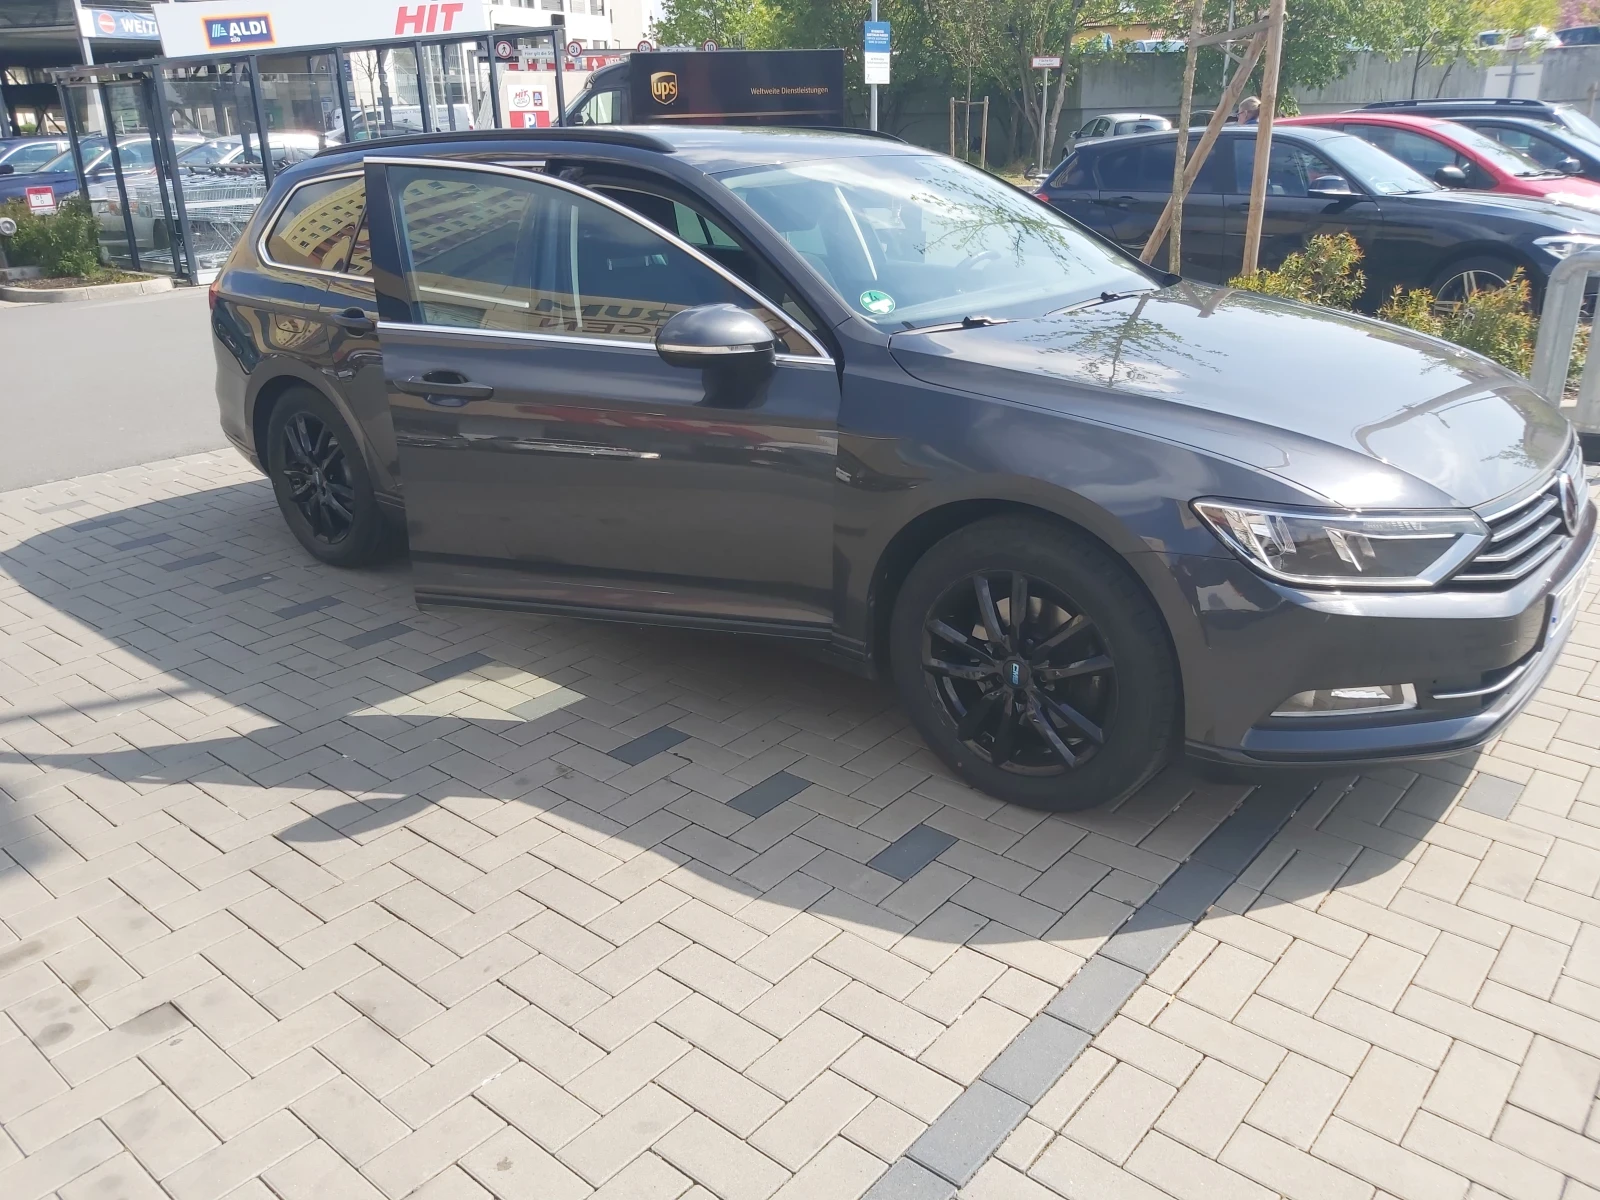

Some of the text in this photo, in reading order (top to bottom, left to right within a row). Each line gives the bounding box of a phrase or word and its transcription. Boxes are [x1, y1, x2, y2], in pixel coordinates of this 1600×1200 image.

[395, 3, 463, 35] HIT
[229, 20, 267, 37] ALDI
[570, 45, 579, 54] 3t
[653, 81, 676, 100] ups
[750, 86, 829, 95] Weltweite Dienstleistungen
